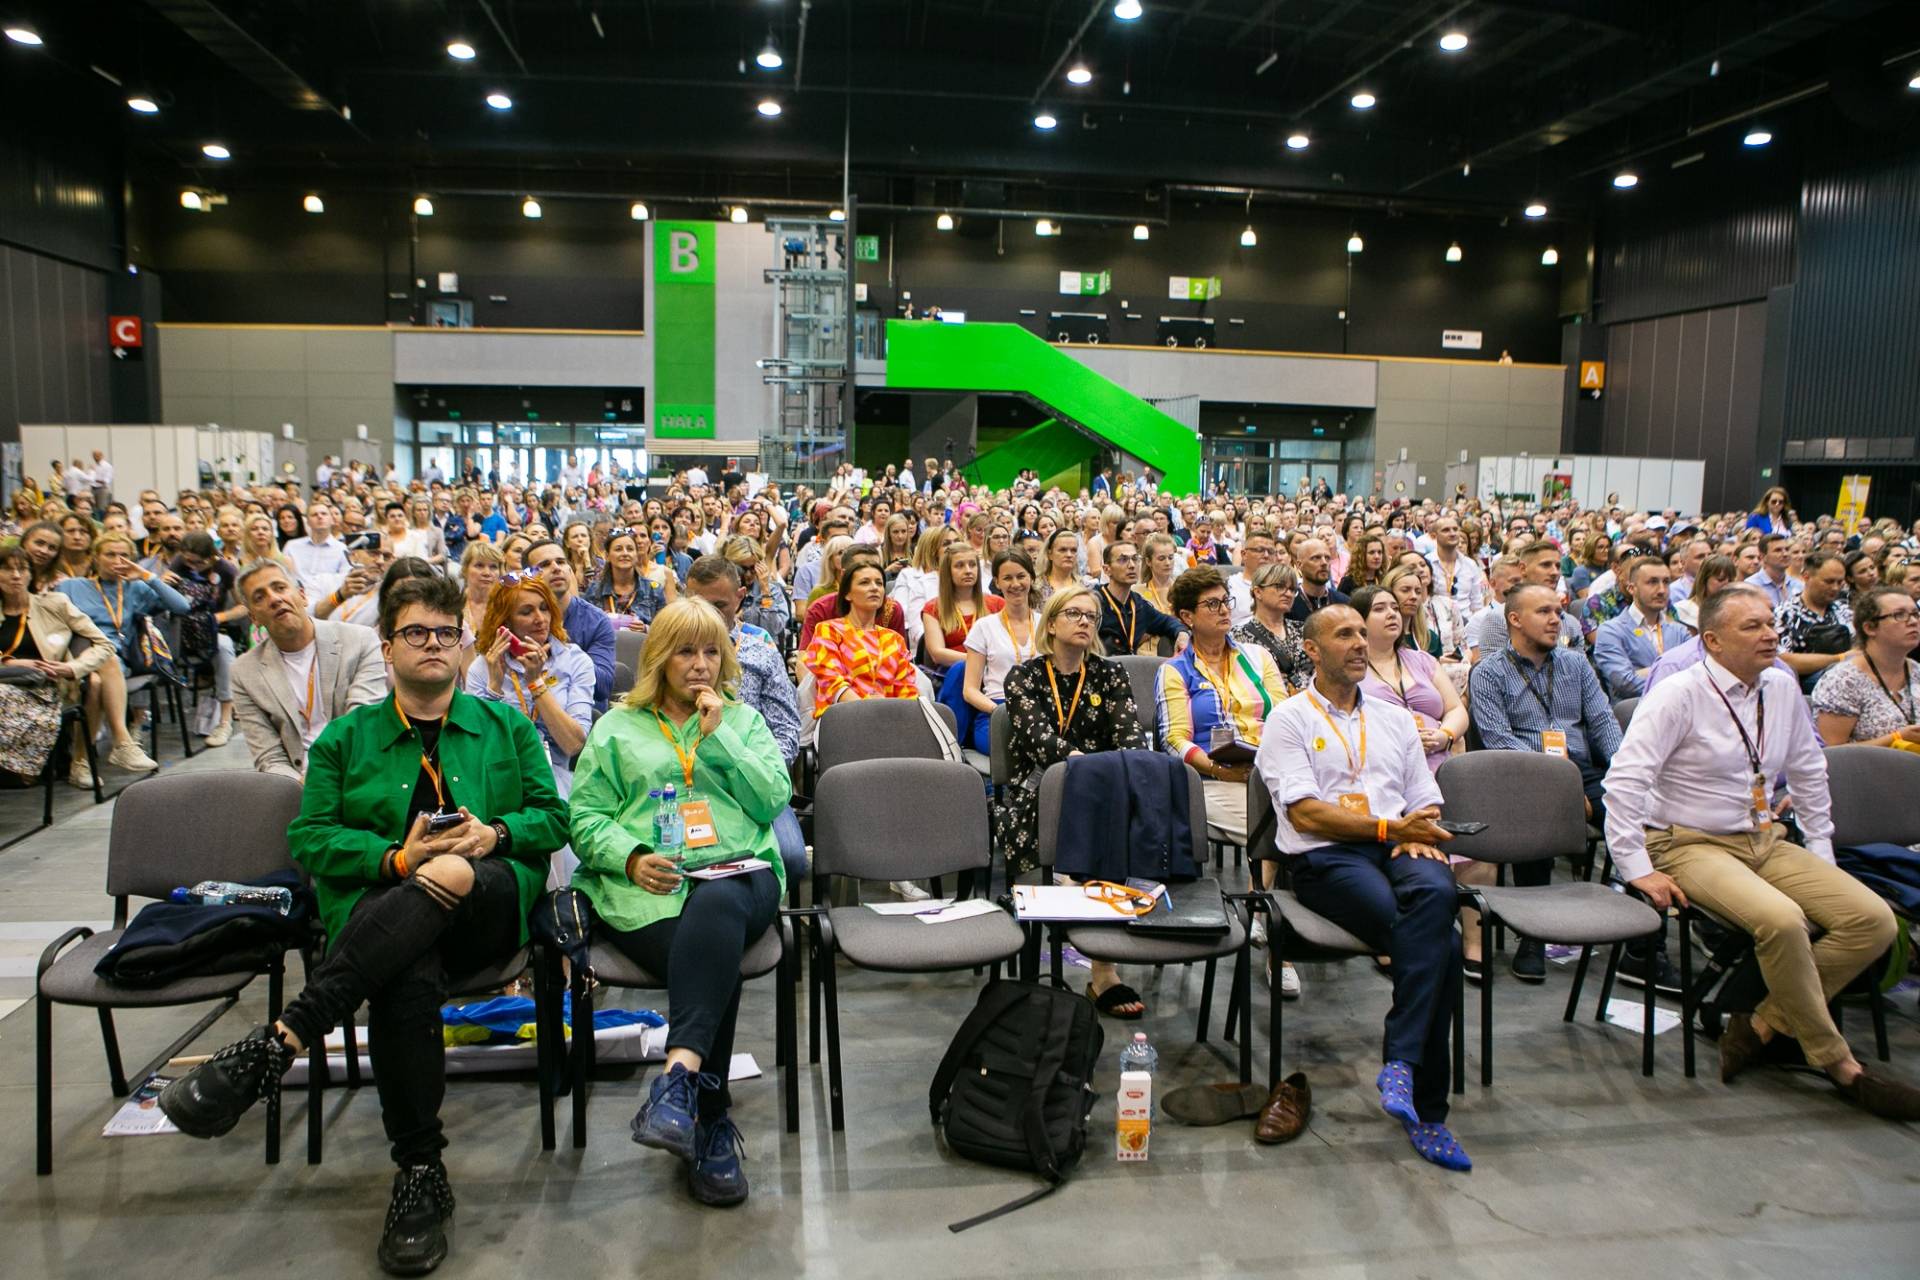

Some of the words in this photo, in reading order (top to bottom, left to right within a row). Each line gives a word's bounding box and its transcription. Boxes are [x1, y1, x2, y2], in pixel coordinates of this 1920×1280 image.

[671, 231, 699, 272] B
[1085, 277, 1095, 290] 3
[1194, 283, 1203, 295] 2
[116, 320, 136, 342] C
[1584, 366, 1599, 384] A
[661, 415, 707, 429] HALA
